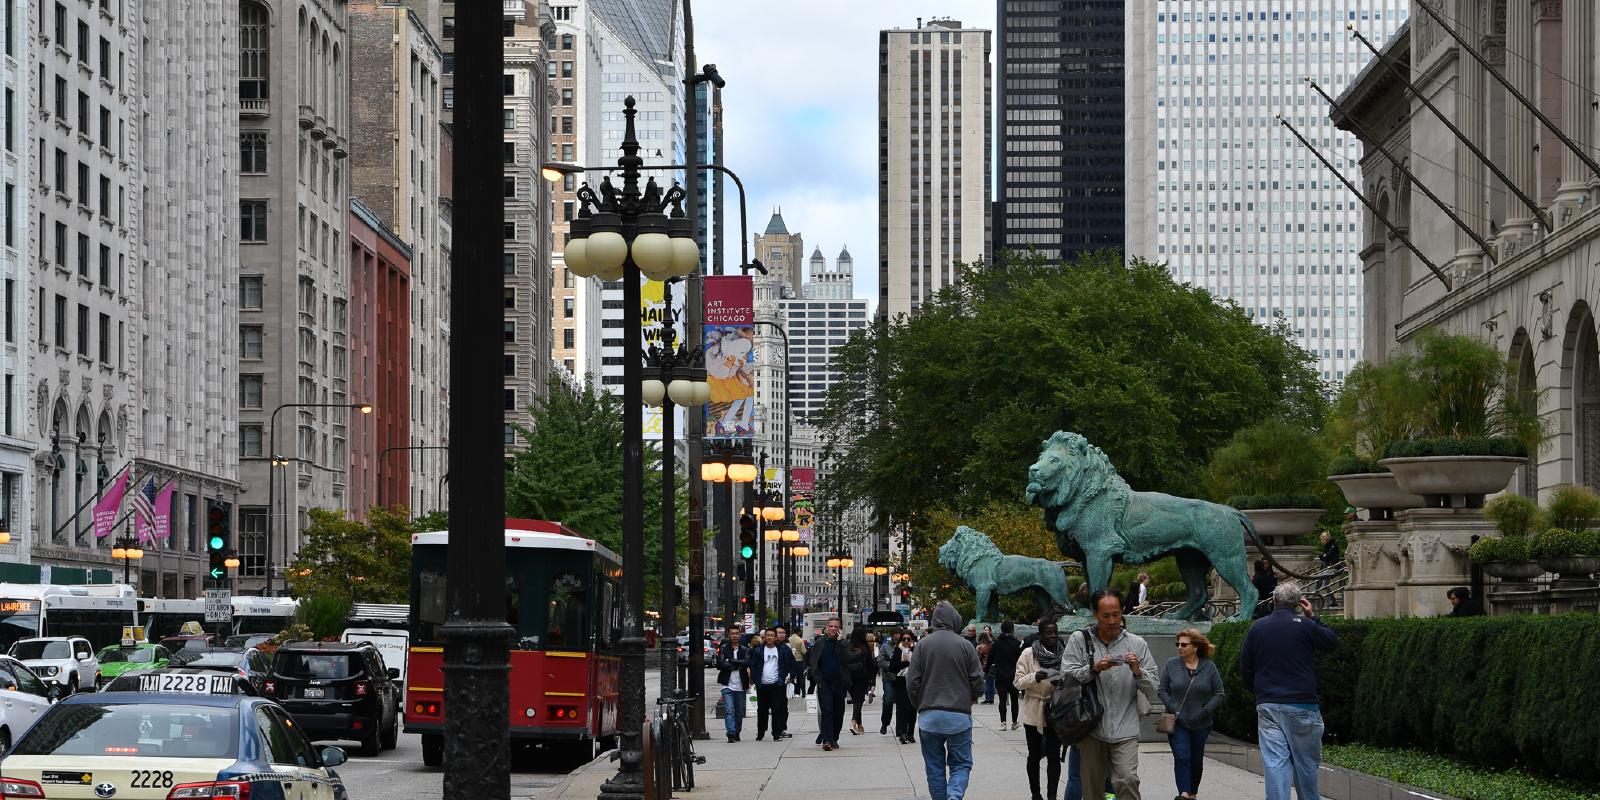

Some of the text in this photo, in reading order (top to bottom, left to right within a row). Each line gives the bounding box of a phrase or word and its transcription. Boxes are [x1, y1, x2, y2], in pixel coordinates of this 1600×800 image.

[1, 601, 32, 612] LAWRENCE
[139, 675, 233, 693] TAXI 2228 TAXI
[130, 770, 174, 789] 2228
